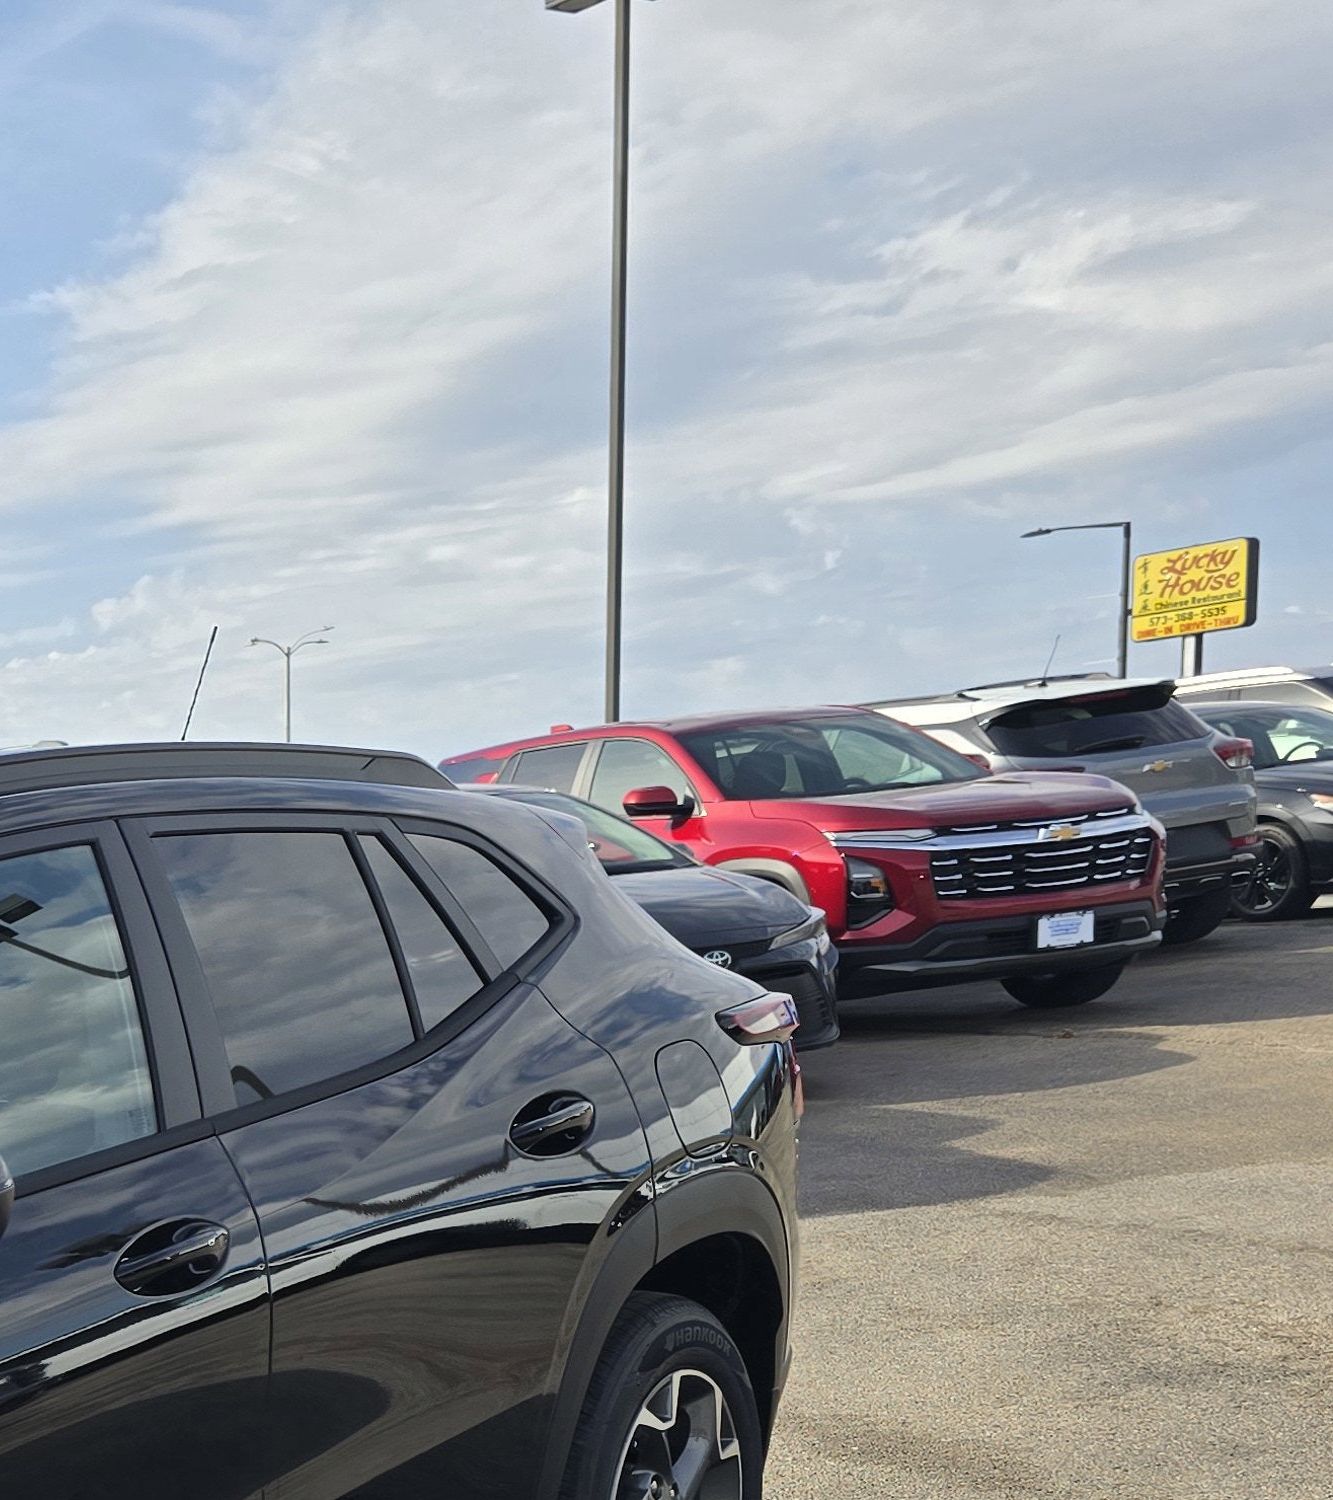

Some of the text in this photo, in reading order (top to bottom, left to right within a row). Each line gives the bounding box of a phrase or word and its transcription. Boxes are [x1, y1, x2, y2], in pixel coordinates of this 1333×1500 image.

[1160, 546, 1239, 576] Lucky
[1158, 571, 1240, 598] House
[1154, 590, 1242, 611] Chinese Restaurant
[1179, 616, 1240, 633] DRIVE-THRU
